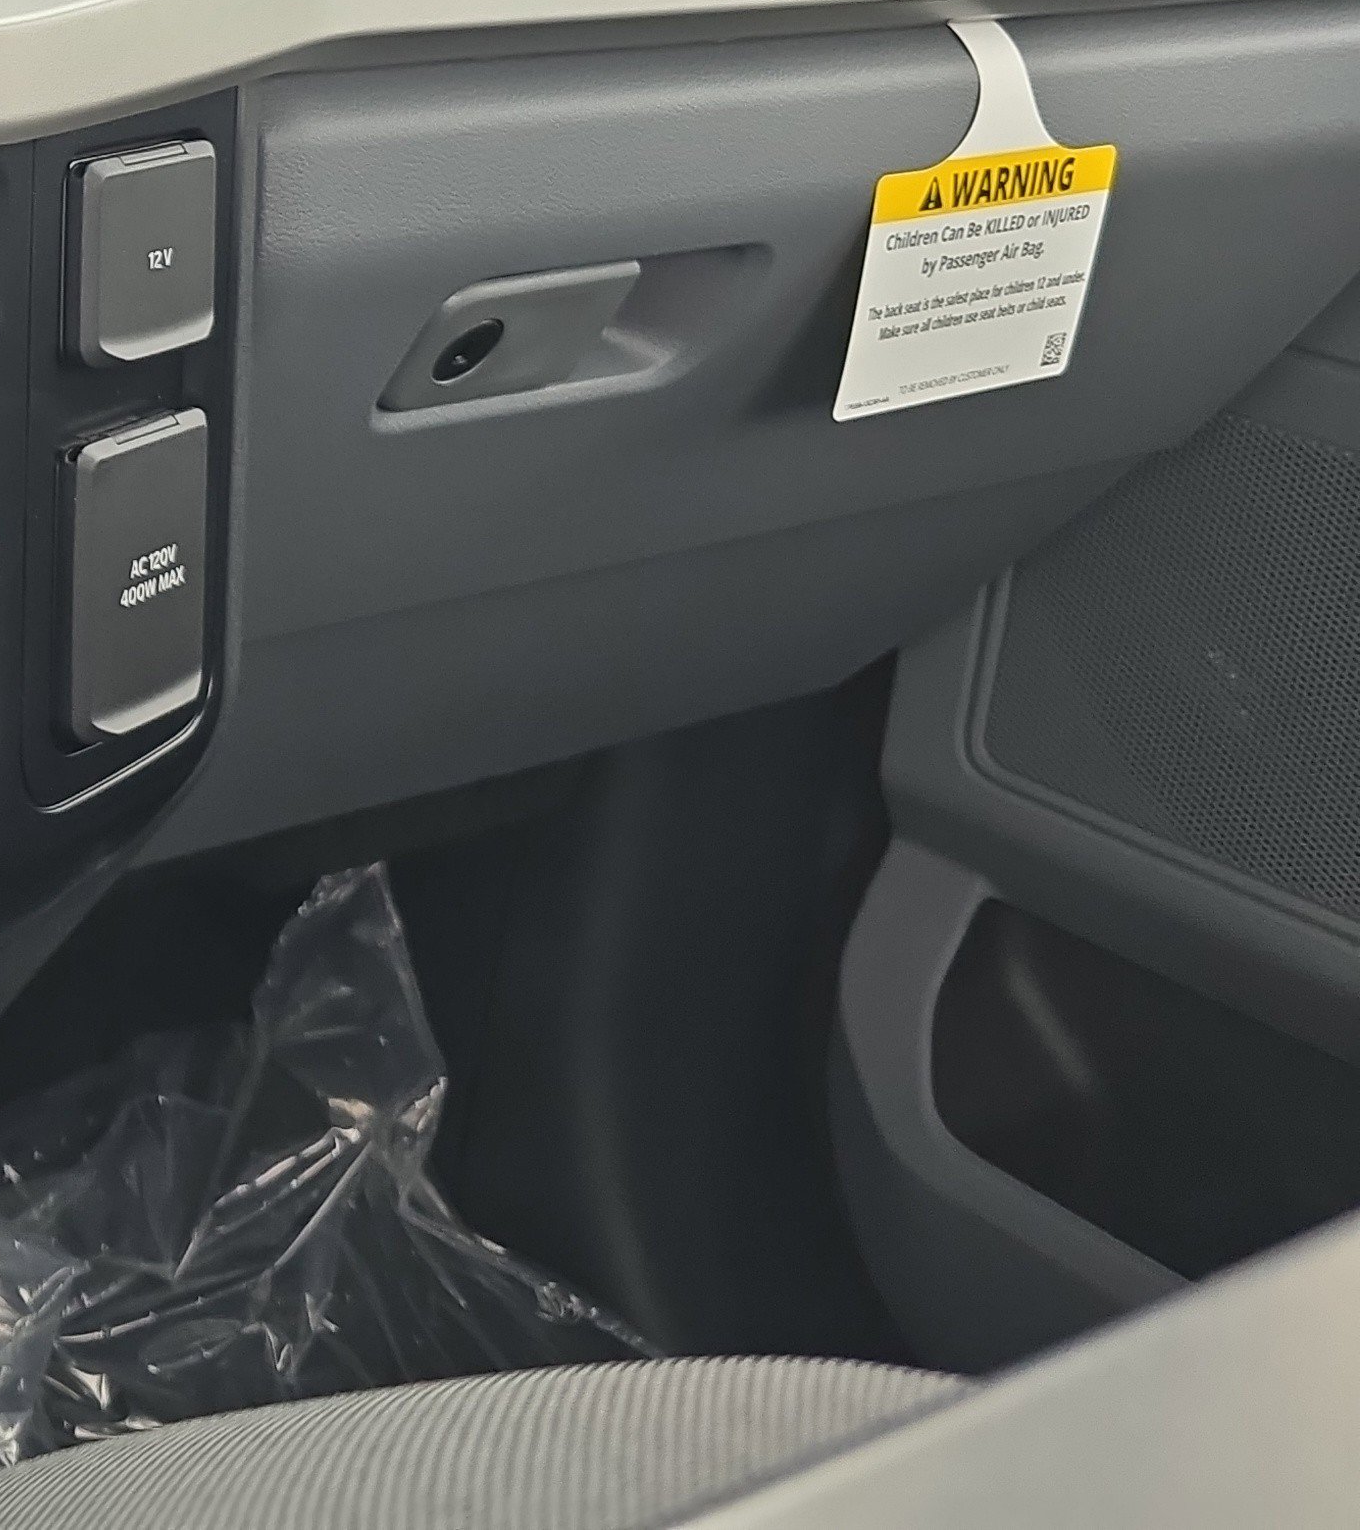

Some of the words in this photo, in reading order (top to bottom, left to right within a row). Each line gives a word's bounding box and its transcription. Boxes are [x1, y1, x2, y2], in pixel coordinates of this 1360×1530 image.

[951, 157, 1076, 208] WARNING
[886, 229, 938, 251] Children
[941, 225, 964, 243] Can
[967, 221, 982, 237] Be
[984, 214, 1025, 235] KILLED
[1027, 213, 1041, 226] or
[1042, 204, 1091, 229] INJURED
[921, 257, 938, 277] by
[939, 248, 999, 271] Passenger
[1000, 243, 1019, 260] Air
[1021, 240, 1044, 259] Bag.
[868, 307, 883, 321] The
[884, 302, 903, 318] back
[903, 300, 921, 315] seat
[922, 298, 930, 311] is
[930, 295, 945, 309] the
[945, 291, 969, 307] safest
[968, 288, 990, 306] place
[991, 284, 1003, 298] for
[1004, 281, 1035, 295] children
[1037, 276, 1046, 290] 12
[1046, 273, 1062, 288] and
[878, 325, 900, 340] Make
[901, 323, 919, 337] sure
[920, 317, 932, 332] all
[931, 314, 963, 330] children
[964, 312, 978, 324] use
[978, 308, 996, 321] seat
[997, 303, 1015, 318] belts
[1017, 303, 1026, 314] or
[1026, 297, 1045, 312] child
[120, 577, 157, 608] 400W
[158, 564, 186, 593] MAX
